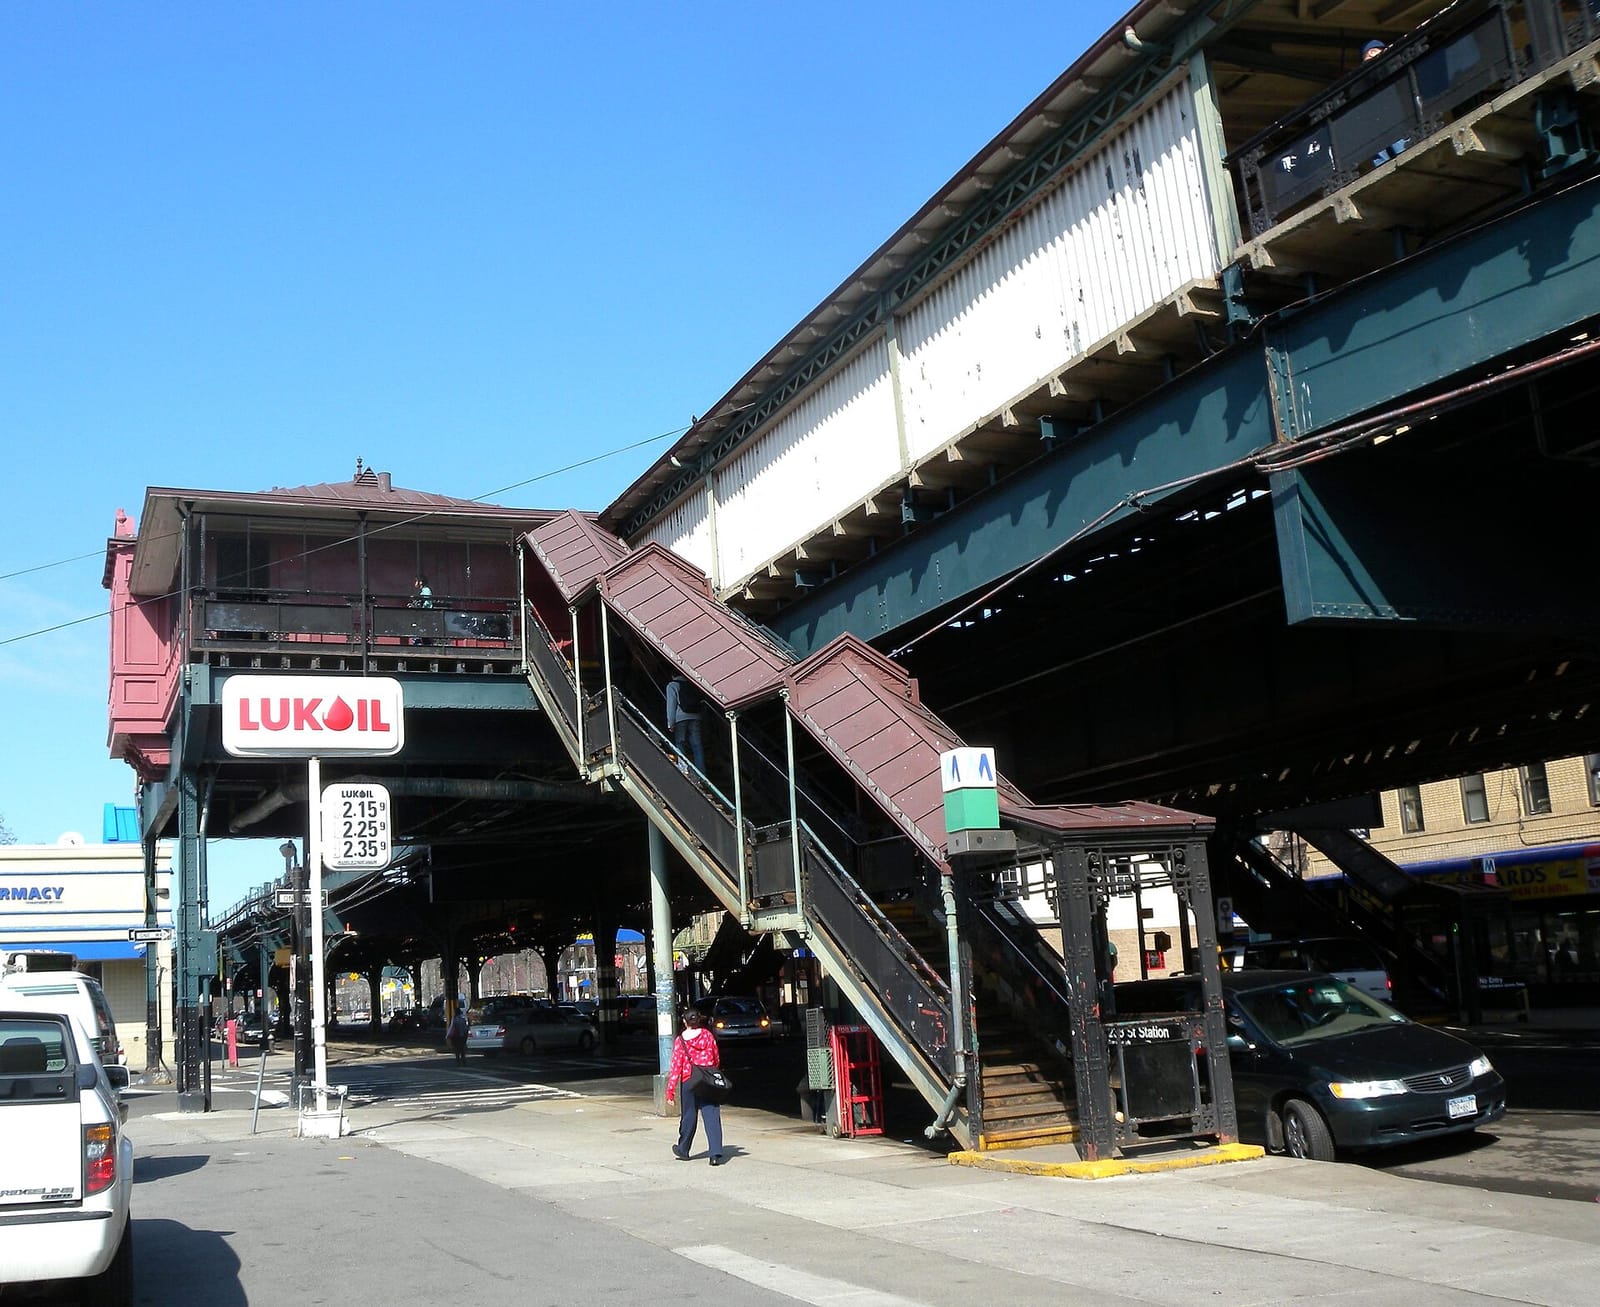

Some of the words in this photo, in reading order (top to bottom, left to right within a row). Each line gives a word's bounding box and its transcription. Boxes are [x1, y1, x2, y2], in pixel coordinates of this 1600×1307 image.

[239, 695, 390, 732] LUKOIL
[341, 790, 374, 798] LUKOIL
[1138, 1025, 1169, 1038] Station
